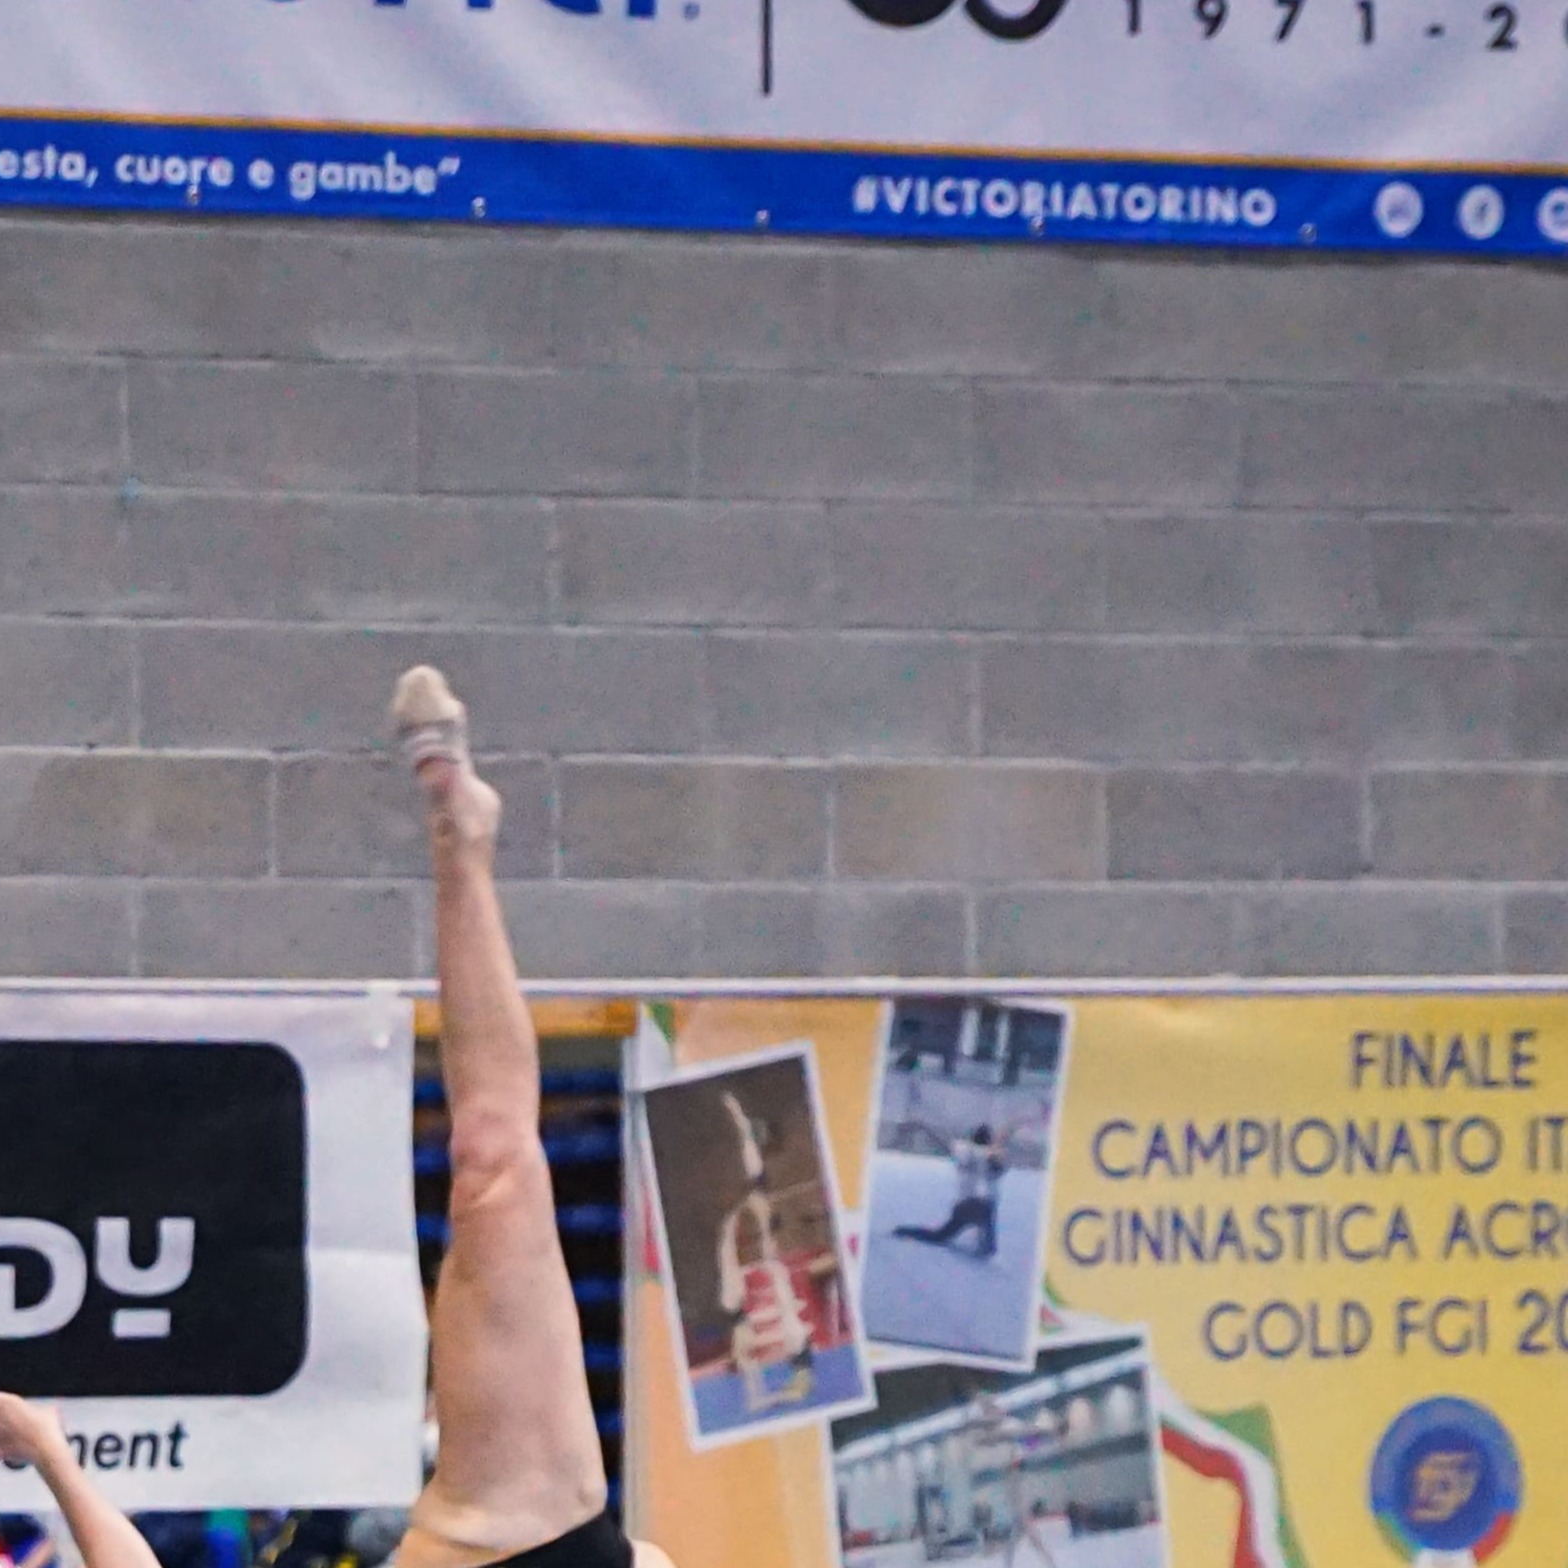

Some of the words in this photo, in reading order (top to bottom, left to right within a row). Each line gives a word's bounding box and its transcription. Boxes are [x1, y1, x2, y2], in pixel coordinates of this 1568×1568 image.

[115, 153, 233, 187] cuore
[248, 158, 274, 189] e
[852, 175, 1277, 227] #VICTORIATORINO
[1351, 1028, 1537, 1090] FINALE
[1090, 1115, 1504, 1178] CAMPIONATO
[1524, 1115, 1568, 1172] IT
[1062, 1203, 1418, 1267] GINNASTICA
[1442, 1199, 1568, 1262] ACR
[1203, 1300, 1372, 1361] GOLD
[1395, 1296, 1488, 1356] FGI
